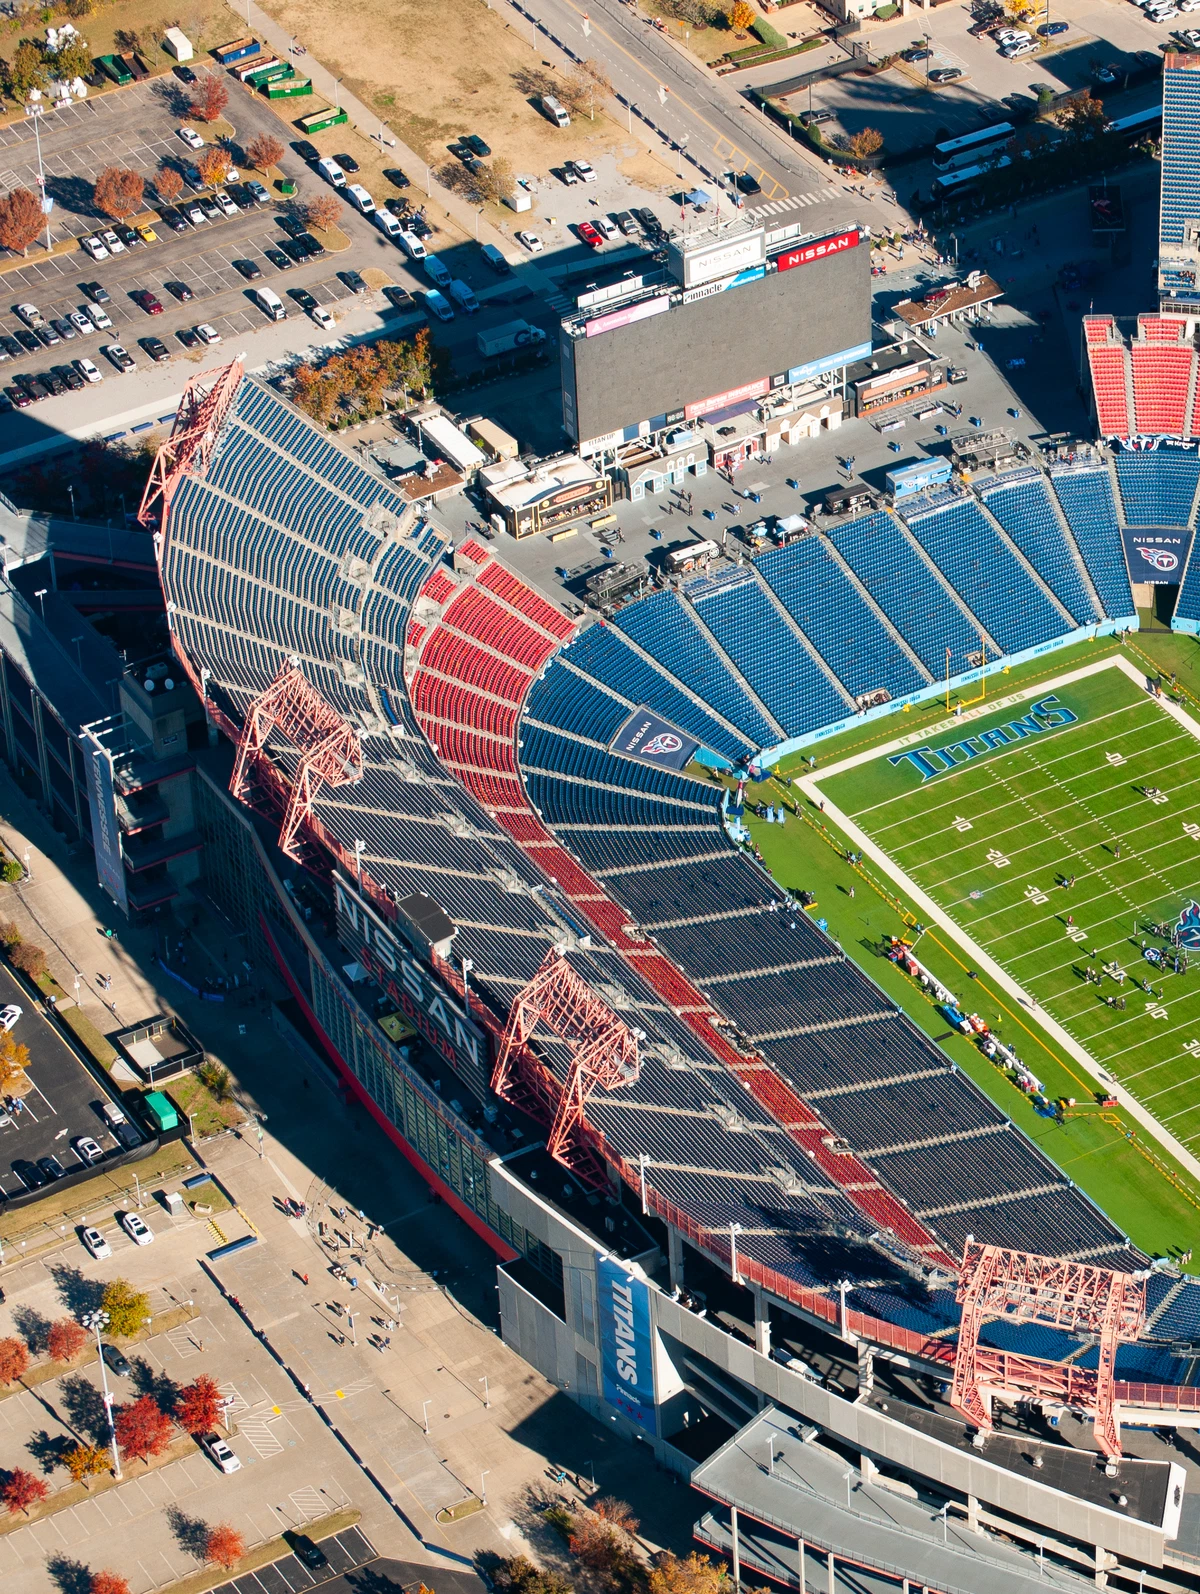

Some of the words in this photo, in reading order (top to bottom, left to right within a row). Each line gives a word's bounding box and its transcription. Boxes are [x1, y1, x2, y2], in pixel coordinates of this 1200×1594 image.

[698, 244, 752, 268] NISSAN
[789, 237, 849, 265] NISSAN
[684, 282, 723, 303] Pinnacle
[728, 381, 765, 400] INSURANCE
[588, 434, 606, 447] TITAN
[897, 733, 916, 746] IT
[916, 719, 956, 740] TAKES
[960, 708, 985, 722] ALL
[988, 701, 1006, 711] OF
[1006, 692, 1026, 704] US
[626, 721, 652, 752] NISSAN
[886, 694, 1079, 784] TITANS
[1106, 753, 1127, 767] 10
[92, 755, 112, 856] TENNESSEE
[951, 818, 974, 833] 10
[986, 850, 1011, 869] 20
[1024, 887, 1049, 906] 30
[1066, 926, 1089, 943] 40
[336, 882, 479, 1066] NISSAN
[361, 948, 457, 1068] STADIUM
[1145, 1002, 1168, 1020] 40
[611, 1280, 638, 1386] TITANS
